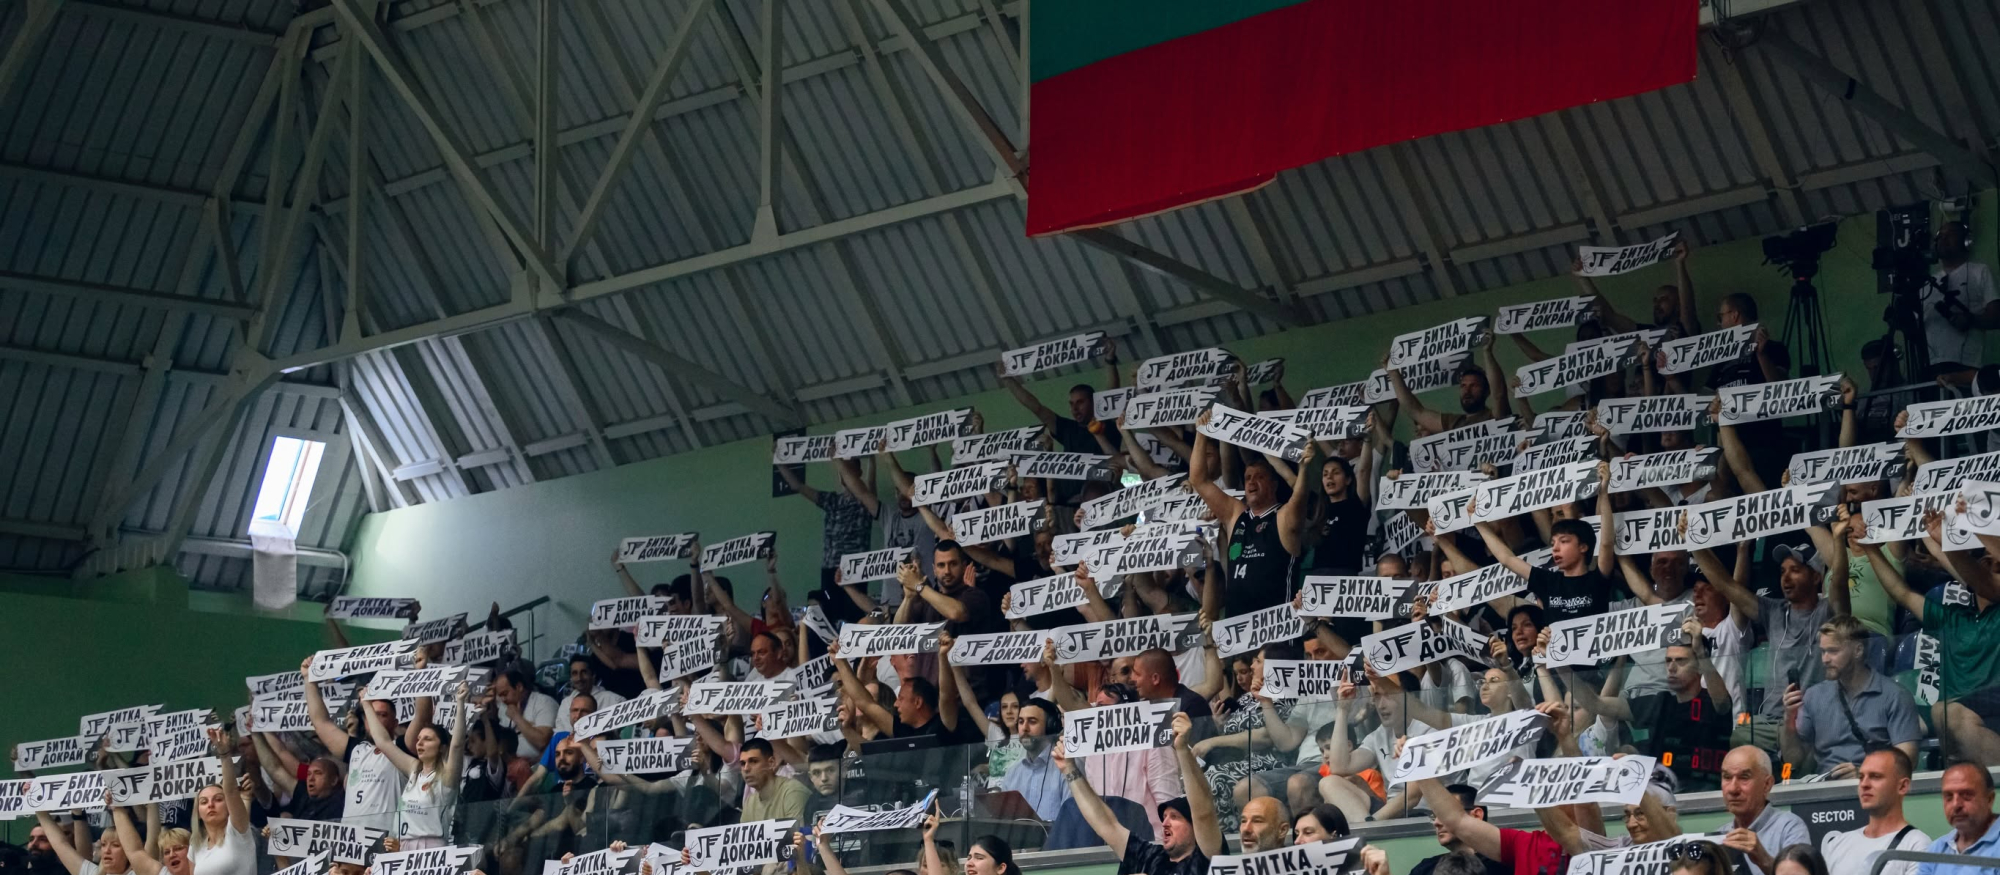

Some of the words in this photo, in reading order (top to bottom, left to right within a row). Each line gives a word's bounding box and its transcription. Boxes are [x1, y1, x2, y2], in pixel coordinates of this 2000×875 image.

[1620, 242, 1656, 258] БИТКА
[1609, 250, 1658, 273] ДОКРАЙ
[1532, 300, 1568, 314] БИТКА
[1524, 308, 1574, 330] ДОКРАЙ
[1424, 322, 1460, 345] БИТКА
[1698, 330, 1734, 350] БИТКА
[1038, 338, 1077, 356] БИТКА
[1420, 332, 1466, 360] ДОКРАЙ
[1690, 341, 1740, 367] ДОКРАЙ
[1034, 347, 1084, 370] ДОКРАЙ
[1172, 352, 1208, 368] БИТКА
[1558, 348, 1604, 370] БИТКА
[1166, 361, 1214, 381] ДОКРАЙ
[1402, 359, 1440, 378] БИТКА
[1554, 356, 1612, 387] ДОКРАЙ
[1763, 380, 1810, 400] БИТКА
[1157, 393, 1191, 410] БИТКА
[1639, 397, 1685, 412] БИТКА
[1757, 392, 1816, 418] ДОКРАЙ
[917, 413, 949, 430] БИТКА
[1150, 405, 1198, 425] ДОКРАЙ
[1295, 409, 1338, 423] БИТКА
[1632, 410, 1692, 430] ДОКРАЙ
[912, 423, 956, 446] ДОКРАЙ
[1243, 418, 1286, 436] БИТКА
[1449, 424, 1489, 442] БИТКА
[983, 431, 1019, 444] БИТКА
[1230, 428, 1285, 452] ДОКРАЙ
[1474, 434, 1516, 453] БИТКА
[1038, 453, 1082, 463] БИТКА
[1544, 440, 1575, 458] БИТКА
[1832, 447, 1876, 466] БИТКА
[1027, 462, 1086, 476] ДОКРАЙ
[1644, 452, 1687, 467] БИТКА
[1954, 454, 2000, 476] БИТКА
[946, 466, 982, 483] БИТКА
[1637, 462, 1691, 486] ДОКРАЙ
[1823, 459, 1880, 480] ДОКРАЙ
[941, 475, 987, 499] ДОКРАЙ
[1417, 474, 1460, 489] БИТКА
[1518, 468, 1566, 492] БИТКА
[1117, 480, 1156, 502] БИТКА
[1510, 480, 1573, 513] ДОКРАЙ
[1736, 490, 1792, 516] БИТКА
[984, 506, 1019, 524] БИТКА
[1654, 510, 1680, 528] БИТ
[1732, 504, 1805, 540] ДОКРАЙ
[981, 516, 1026, 540] ДОКРАЙ
[646, 536, 676, 547] БИТКА
[724, 538, 751, 552] БИТКА
[1124, 538, 1167, 554] БИТКА
[638, 546, 676, 559] ДОКРАЙ
[718, 546, 755, 566] ДОКРАЙ
[866, 551, 894, 565] БИТКА
[1117, 549, 1174, 572] ДОКРАЙ
[862, 560, 897, 579] ДОКРАЙ
[1234, 564, 1247, 578] 14
[1048, 574, 1075, 592] БИТ
[1340, 580, 1382, 595] БИТКА
[351, 605, 394, 617] ДОКРАЙ
[358, 598, 392, 607] БИТКА
[617, 599, 648, 610] БИТКА
[1333, 595, 1390, 614] ДОКРАЙ
[668, 618, 702, 629] БИТКА
[1252, 606, 1292, 629] БИТКА
[1595, 610, 1648, 634] БИТКА
[874, 626, 915, 636] БИТКА
[1104, 619, 1160, 638] БИТКА
[1248, 615, 1300, 648] ДОКРАЙ
[1421, 619, 1464, 642] БТКА
[464, 634, 490, 650] БИТКА
[679, 635, 705, 657] БИТКА
[866, 635, 916, 654] ДОКРАЙ
[992, 633, 1038, 648] БИТКА
[1099, 630, 1171, 657] ДОКРАЙ
[1588, 624, 1658, 658] ДОКРАЙ
[348, 643, 392, 658] БИТКА
[462, 645, 496, 664] ДОКРАЙ
[981, 644, 1041, 662] ДОКРАЙ
[680, 651, 712, 673] ДОКРАЙ
[402, 669, 442, 683] БИТКА
[391, 681, 441, 696] ДОКРАЙ
[724, 684, 764, 697] БИТКА
[1298, 680, 1331, 696] ДОКР
[285, 703, 308, 714] БИТ
[612, 695, 653, 716] БИТКА
[714, 695, 768, 712] ДОКРАЙ
[787, 702, 817, 719] БИТКА
[108, 708, 141, 724] БИТКА
[166, 712, 194, 727] БИТКА
[280, 715, 311, 729] ДОКР
[602, 706, 655, 731] ДОКРАЙ
[782, 714, 823, 736] ДОКРАЙ
[1098, 706, 1142, 726] БИТКА
[174, 728, 201, 745] БИТКА
[1094, 723, 1150, 752] ДОКРАЙ
[1447, 718, 1505, 749] БИТКА
[46, 739, 78, 753] БИТКА
[169, 739, 207, 761] ДОКРАЙ
[628, 740, 664, 755] БИТКА
[1437, 730, 1512, 774] ДОКРАЙ
[41, 749, 84, 766] ДОКРАЙ
[626, 754, 672, 771] ДОКРАЙ
[154, 760, 205, 782] БИТКА
[0, 782, 23, 797] ИТК
[68, 773, 103, 790] БИТК
[60, 787, 107, 807] ДОКРА
[356, 791, 363, 804] 5
[1529, 782, 1580, 804] БИТКА
[1812, 810, 1854, 824] SECTOR
[312, 824, 356, 843] БИТКА
[723, 824, 764, 844] БИТКА
[406, 850, 446, 870] БИТКА
[719, 838, 772, 866] ДОКРАЙ
[573, 852, 607, 873] БИТКА
[1242, 849, 1312, 875] БИТКА
